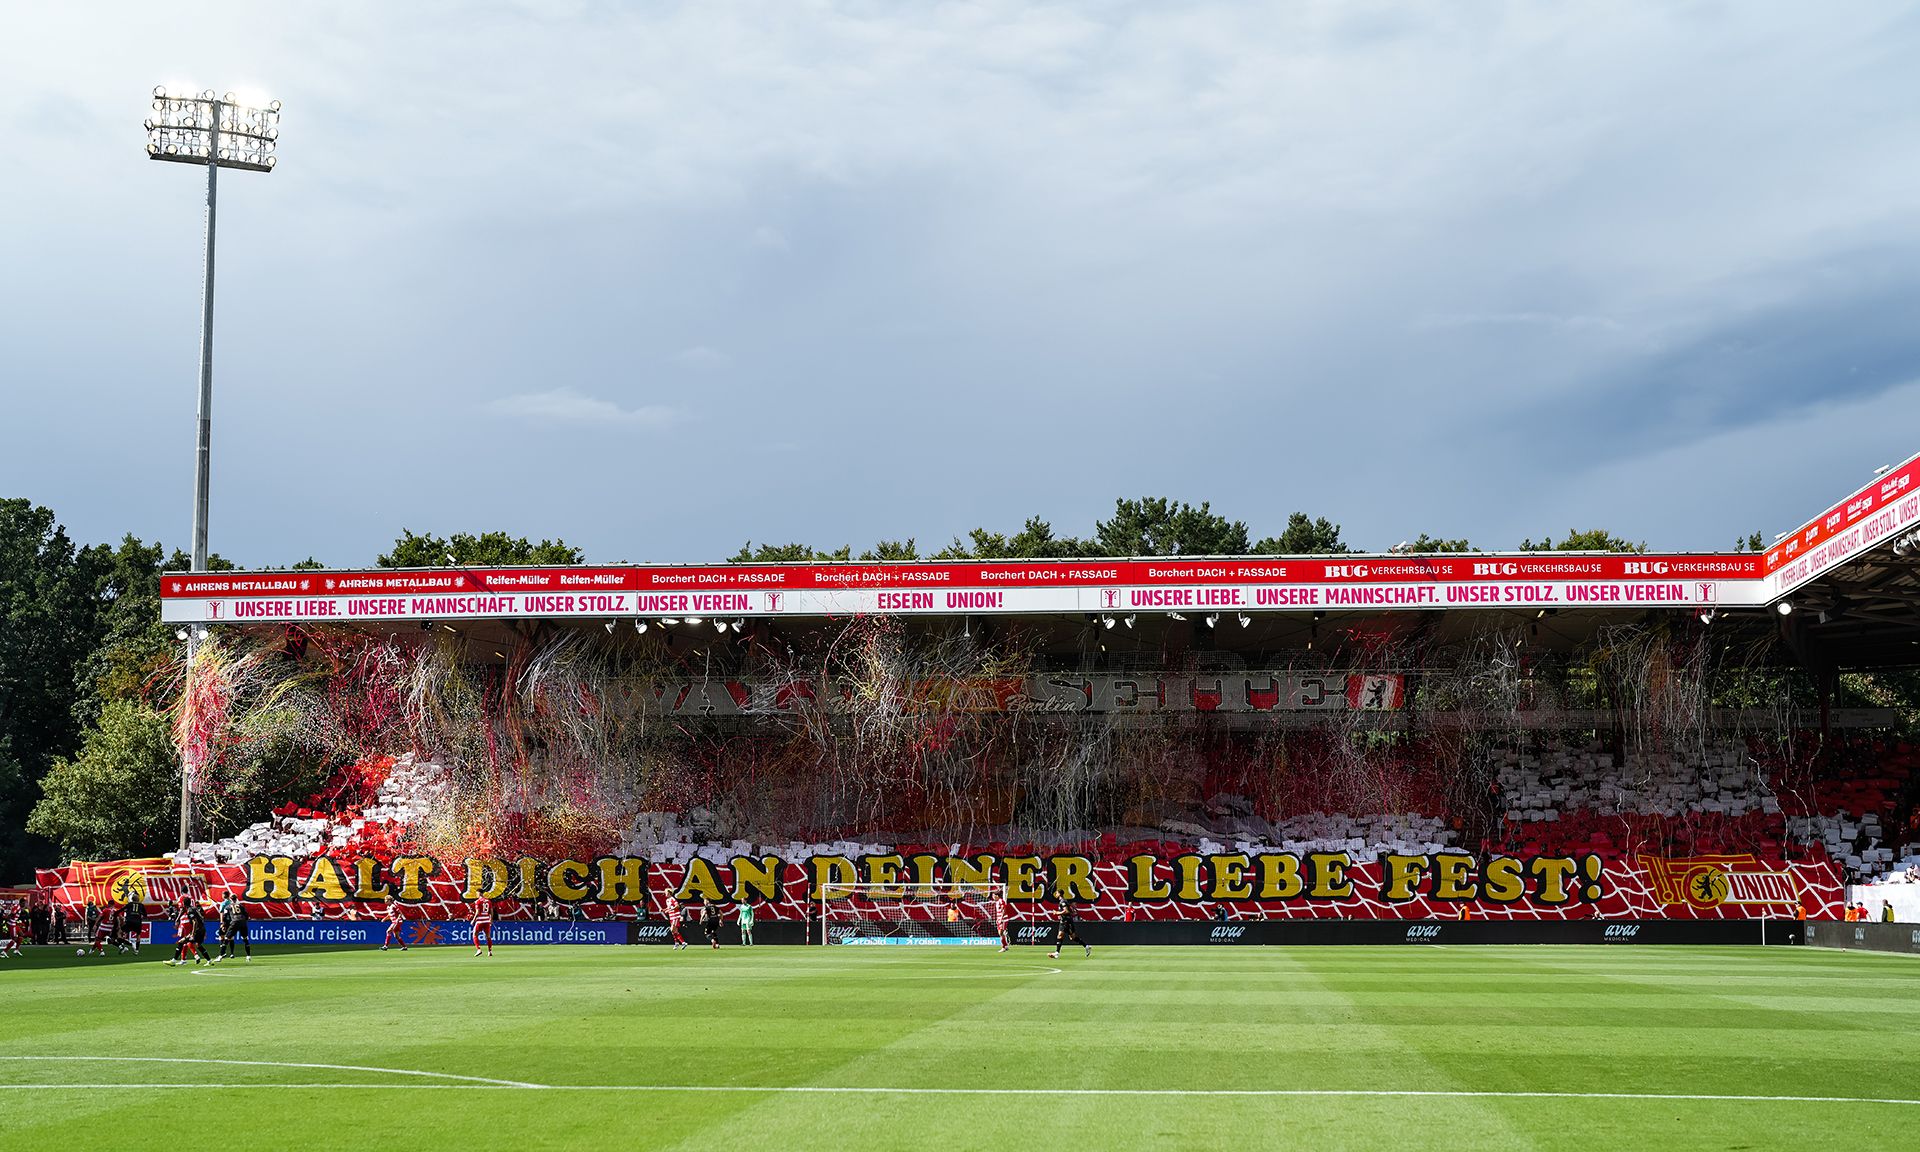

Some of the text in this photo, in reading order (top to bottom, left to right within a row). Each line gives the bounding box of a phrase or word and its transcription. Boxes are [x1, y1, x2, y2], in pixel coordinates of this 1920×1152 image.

[1862, 519, 1879, 544] UNSER
[1899, 496, 1918, 524] UNSER
[1149, 569, 1193, 577] Borchert
[1238, 568, 1286, 576] FASSADE
[1325, 565, 1368, 577] BUG
[1372, 566, 1439, 574] VERKEHRSBAU
[1474, 563, 1517, 575] BUG
[1591, 564, 1601, 572] SE
[1625, 562, 1668, 574] BUG
[1672, 563, 1741, 571] VERKEHRSBAU
[487, 575, 550, 584] Reifen-Müller
[561, 575, 625, 584] Reifen-Müller
[653, 575, 695, 583] Borchert
[738, 574, 784, 582] FASSADE
[816, 571, 859, 582] Borchert
[863, 571, 890, 581] DACH
[903, 572, 949, 580] FASSADE
[981, 571, 1025, 579] Borchert
[1029, 571, 1056, 579] DACH
[1070, 570, 1117, 578] FASSADE
[186, 581, 296, 591] AHRENS METALLBAU
[339, 578, 451, 587] AHRENS METALLBAU
[878, 592, 1002, 609] EISERN UNION!
[1132, 585, 1688, 606] UNSERE LIEBE. UNSERE MANNSCHAFT. UNSER STOLZ. UNSER VEREIN.
[236, 595, 752, 617] UNSERE LIEBE. UNSERE MANNSCHAFT. UNSER STOLZ. UNSER VEREIN.
[246, 853, 1602, 902] HALT DICH AN DEINER LIEBE FEST!
[1730, 874, 1797, 900] UNION
[132, 903, 139, 912] 11
[231, 904, 241, 914] 16
[215, 926, 366, 940] suinsland reisen
[558, 927, 606, 941] reisen
